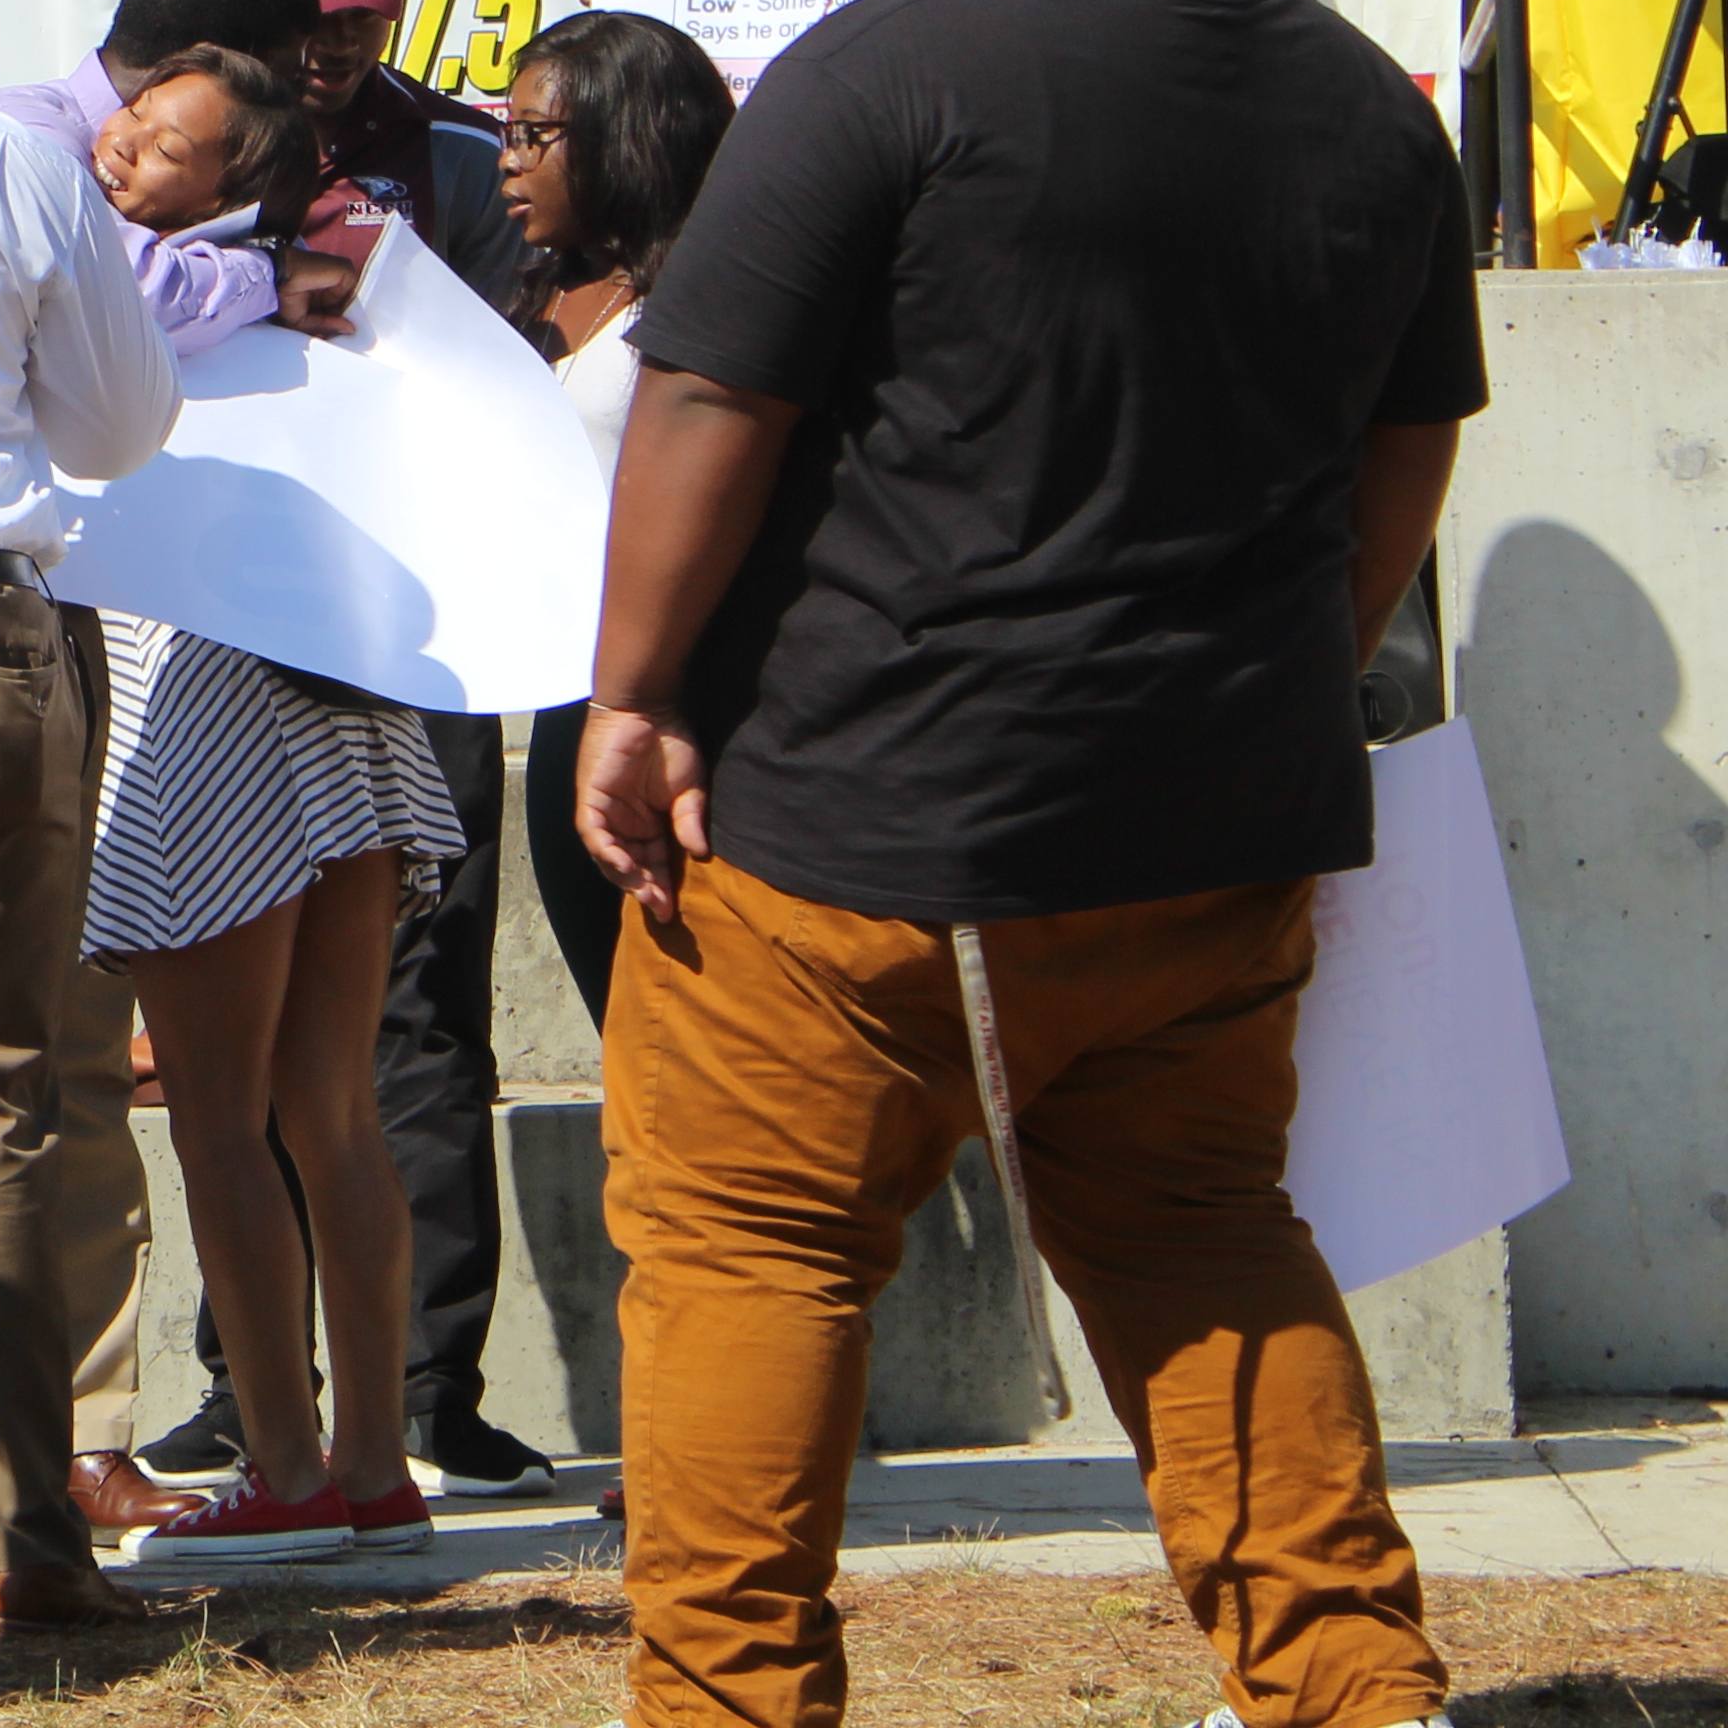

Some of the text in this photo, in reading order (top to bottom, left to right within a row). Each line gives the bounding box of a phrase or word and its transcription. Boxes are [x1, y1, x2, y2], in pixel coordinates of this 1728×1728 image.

[686, 20, 800, 44] Says he or
